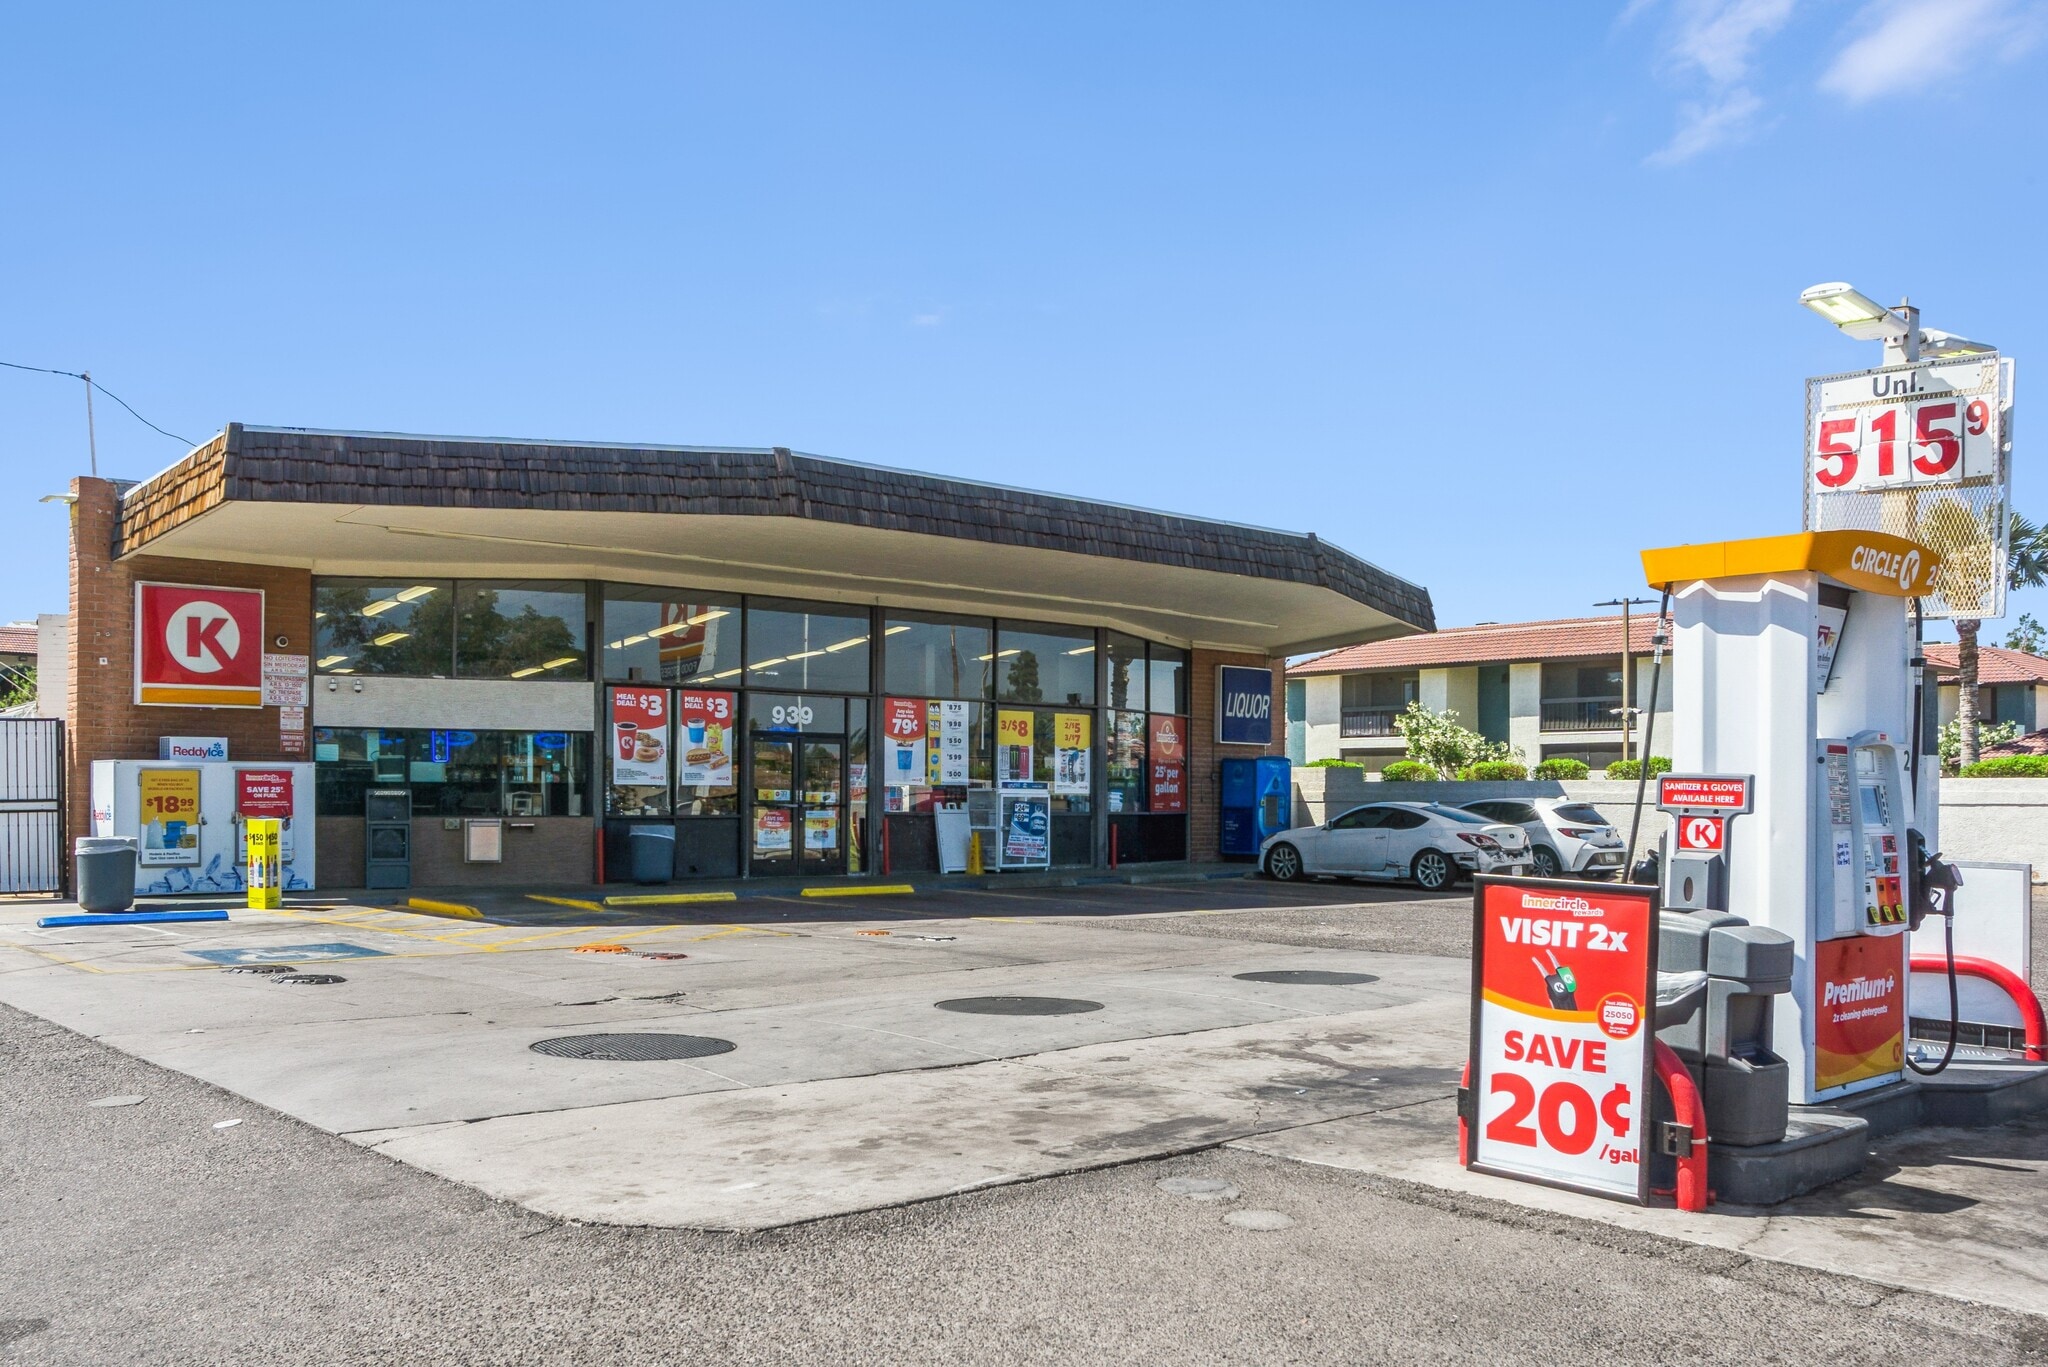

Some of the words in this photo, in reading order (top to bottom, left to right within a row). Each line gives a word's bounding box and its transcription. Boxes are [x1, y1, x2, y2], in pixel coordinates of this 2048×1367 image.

[1873, 371, 1924, 398] Unl.
[1851, 545, 1901, 578] CIRCLE
[1926, 565, 1937, 586] 2
[187, 616, 234, 669] K
[771, 705, 813, 724] 939
[1225, 692, 1270, 719] LIQUOR
[892, 718, 918, 734] 79¢
[1001, 720, 1028, 737] 3/$8
[1064, 722, 1081, 733] 2/$5
[1064, 734, 1081, 745] 3/$7
[1903, 750, 1910, 771] 2
[1167, 769, 1178, 780] per
[1664, 783, 1702, 791] SANITIZER
[1702, 783, 1709, 791] &
[1710, 783, 1743, 792] GLOVES
[1672, 794, 1713, 802] AVAILABLE
[1714, 795, 1735, 803] HERE
[1523, 895, 1587, 910] innercircle
[1500, 916, 1584, 948] VISIT
[1587, 923, 1629, 952] 2x
[1605, 1010, 1632, 1020] 25050
[1832, 1013, 1839, 1023] 2x
[1840, 1009, 1861, 1023] cleaning
[1504, 1030, 1607, 1074] SAVE
[1486, 1072, 1631, 1156] 20¢
